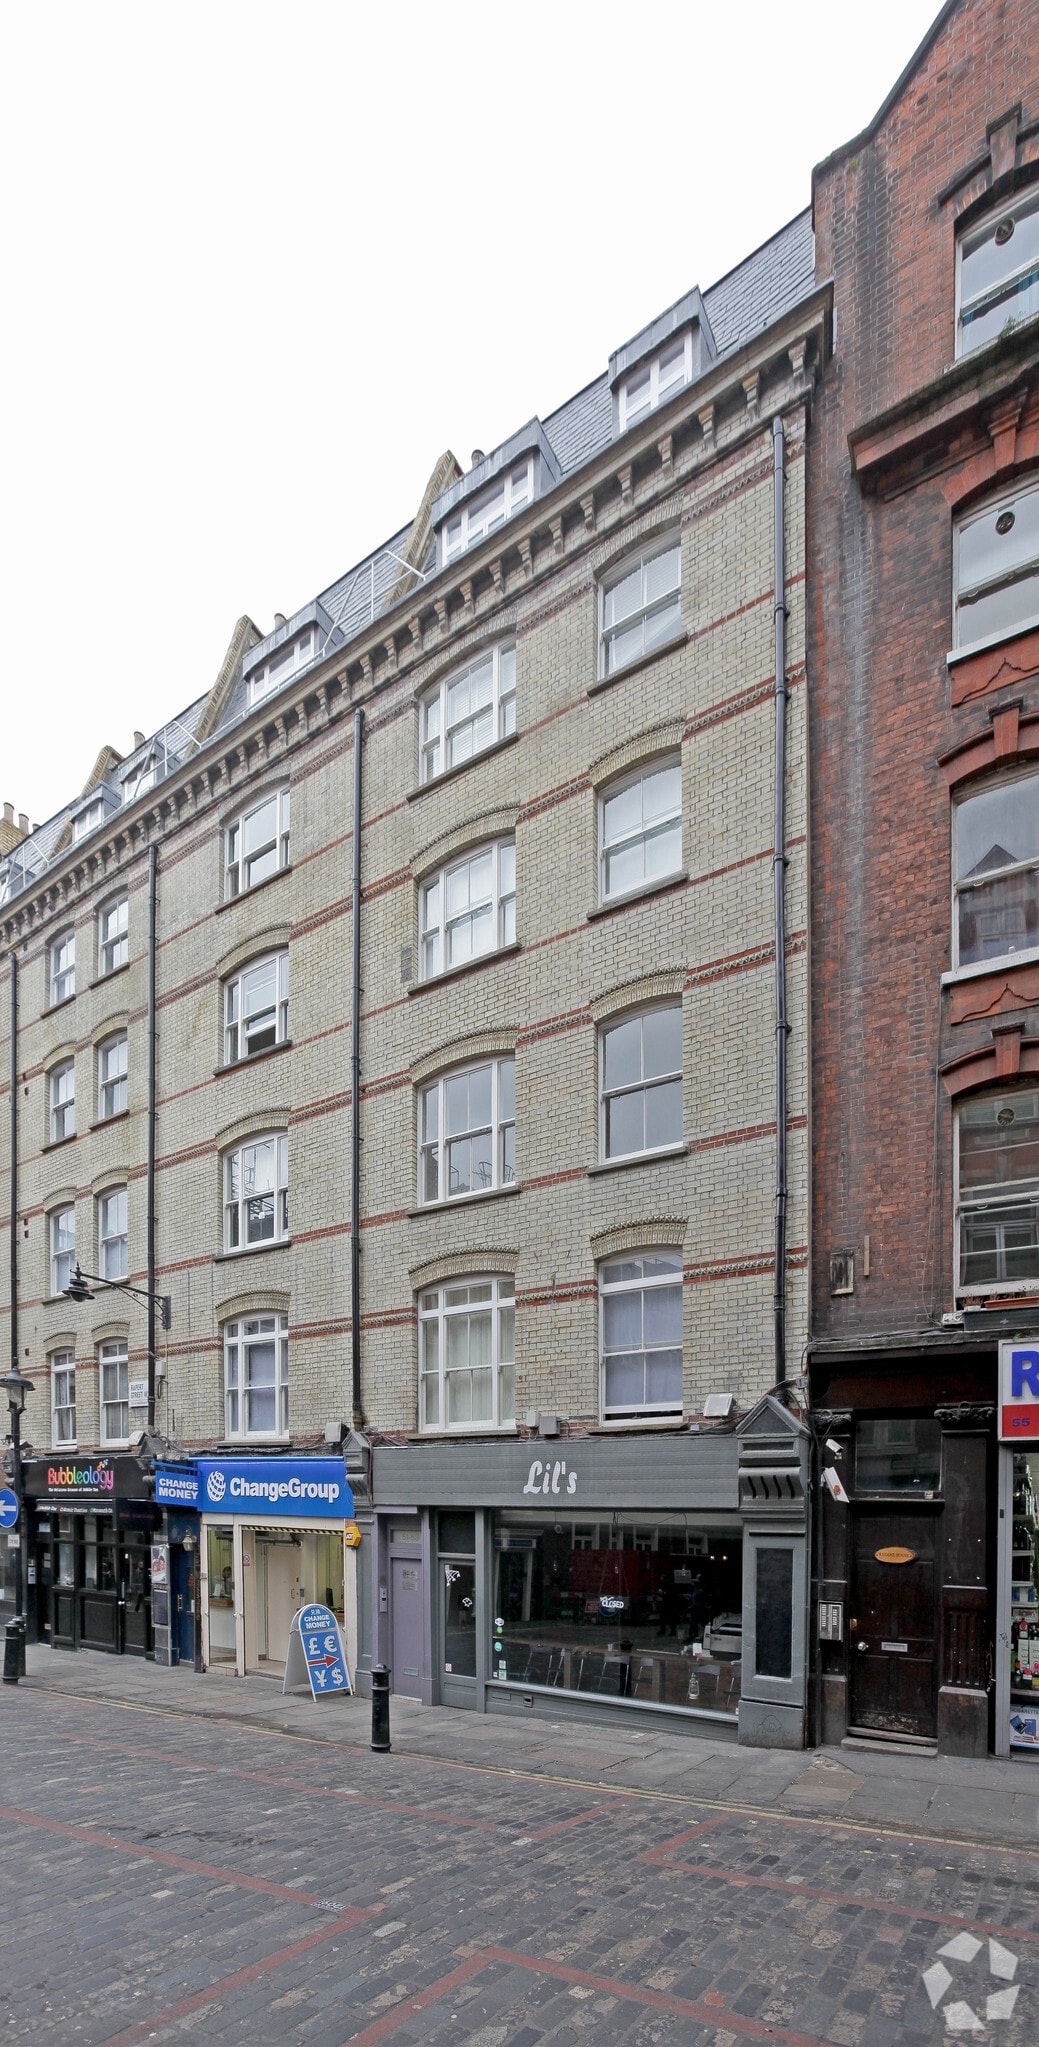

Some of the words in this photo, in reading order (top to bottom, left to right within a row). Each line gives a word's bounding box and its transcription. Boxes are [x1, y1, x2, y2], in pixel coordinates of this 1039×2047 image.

[1012, 1417, 1030, 1427] 55
[48, 1466, 113, 1490] Bubbleology
[523, 1460, 578, 1494] Lil's
[158, 1477, 199, 1491] CHANGE
[229, 1477, 340, 1503] ChangeGroup
[158, 1487, 199, 1500] MONEY
[601, 1600, 625, 1609] CLOSED
[304, 1614, 330, 1622] CHANGE
[305, 1620, 331, 1629] MONEY
